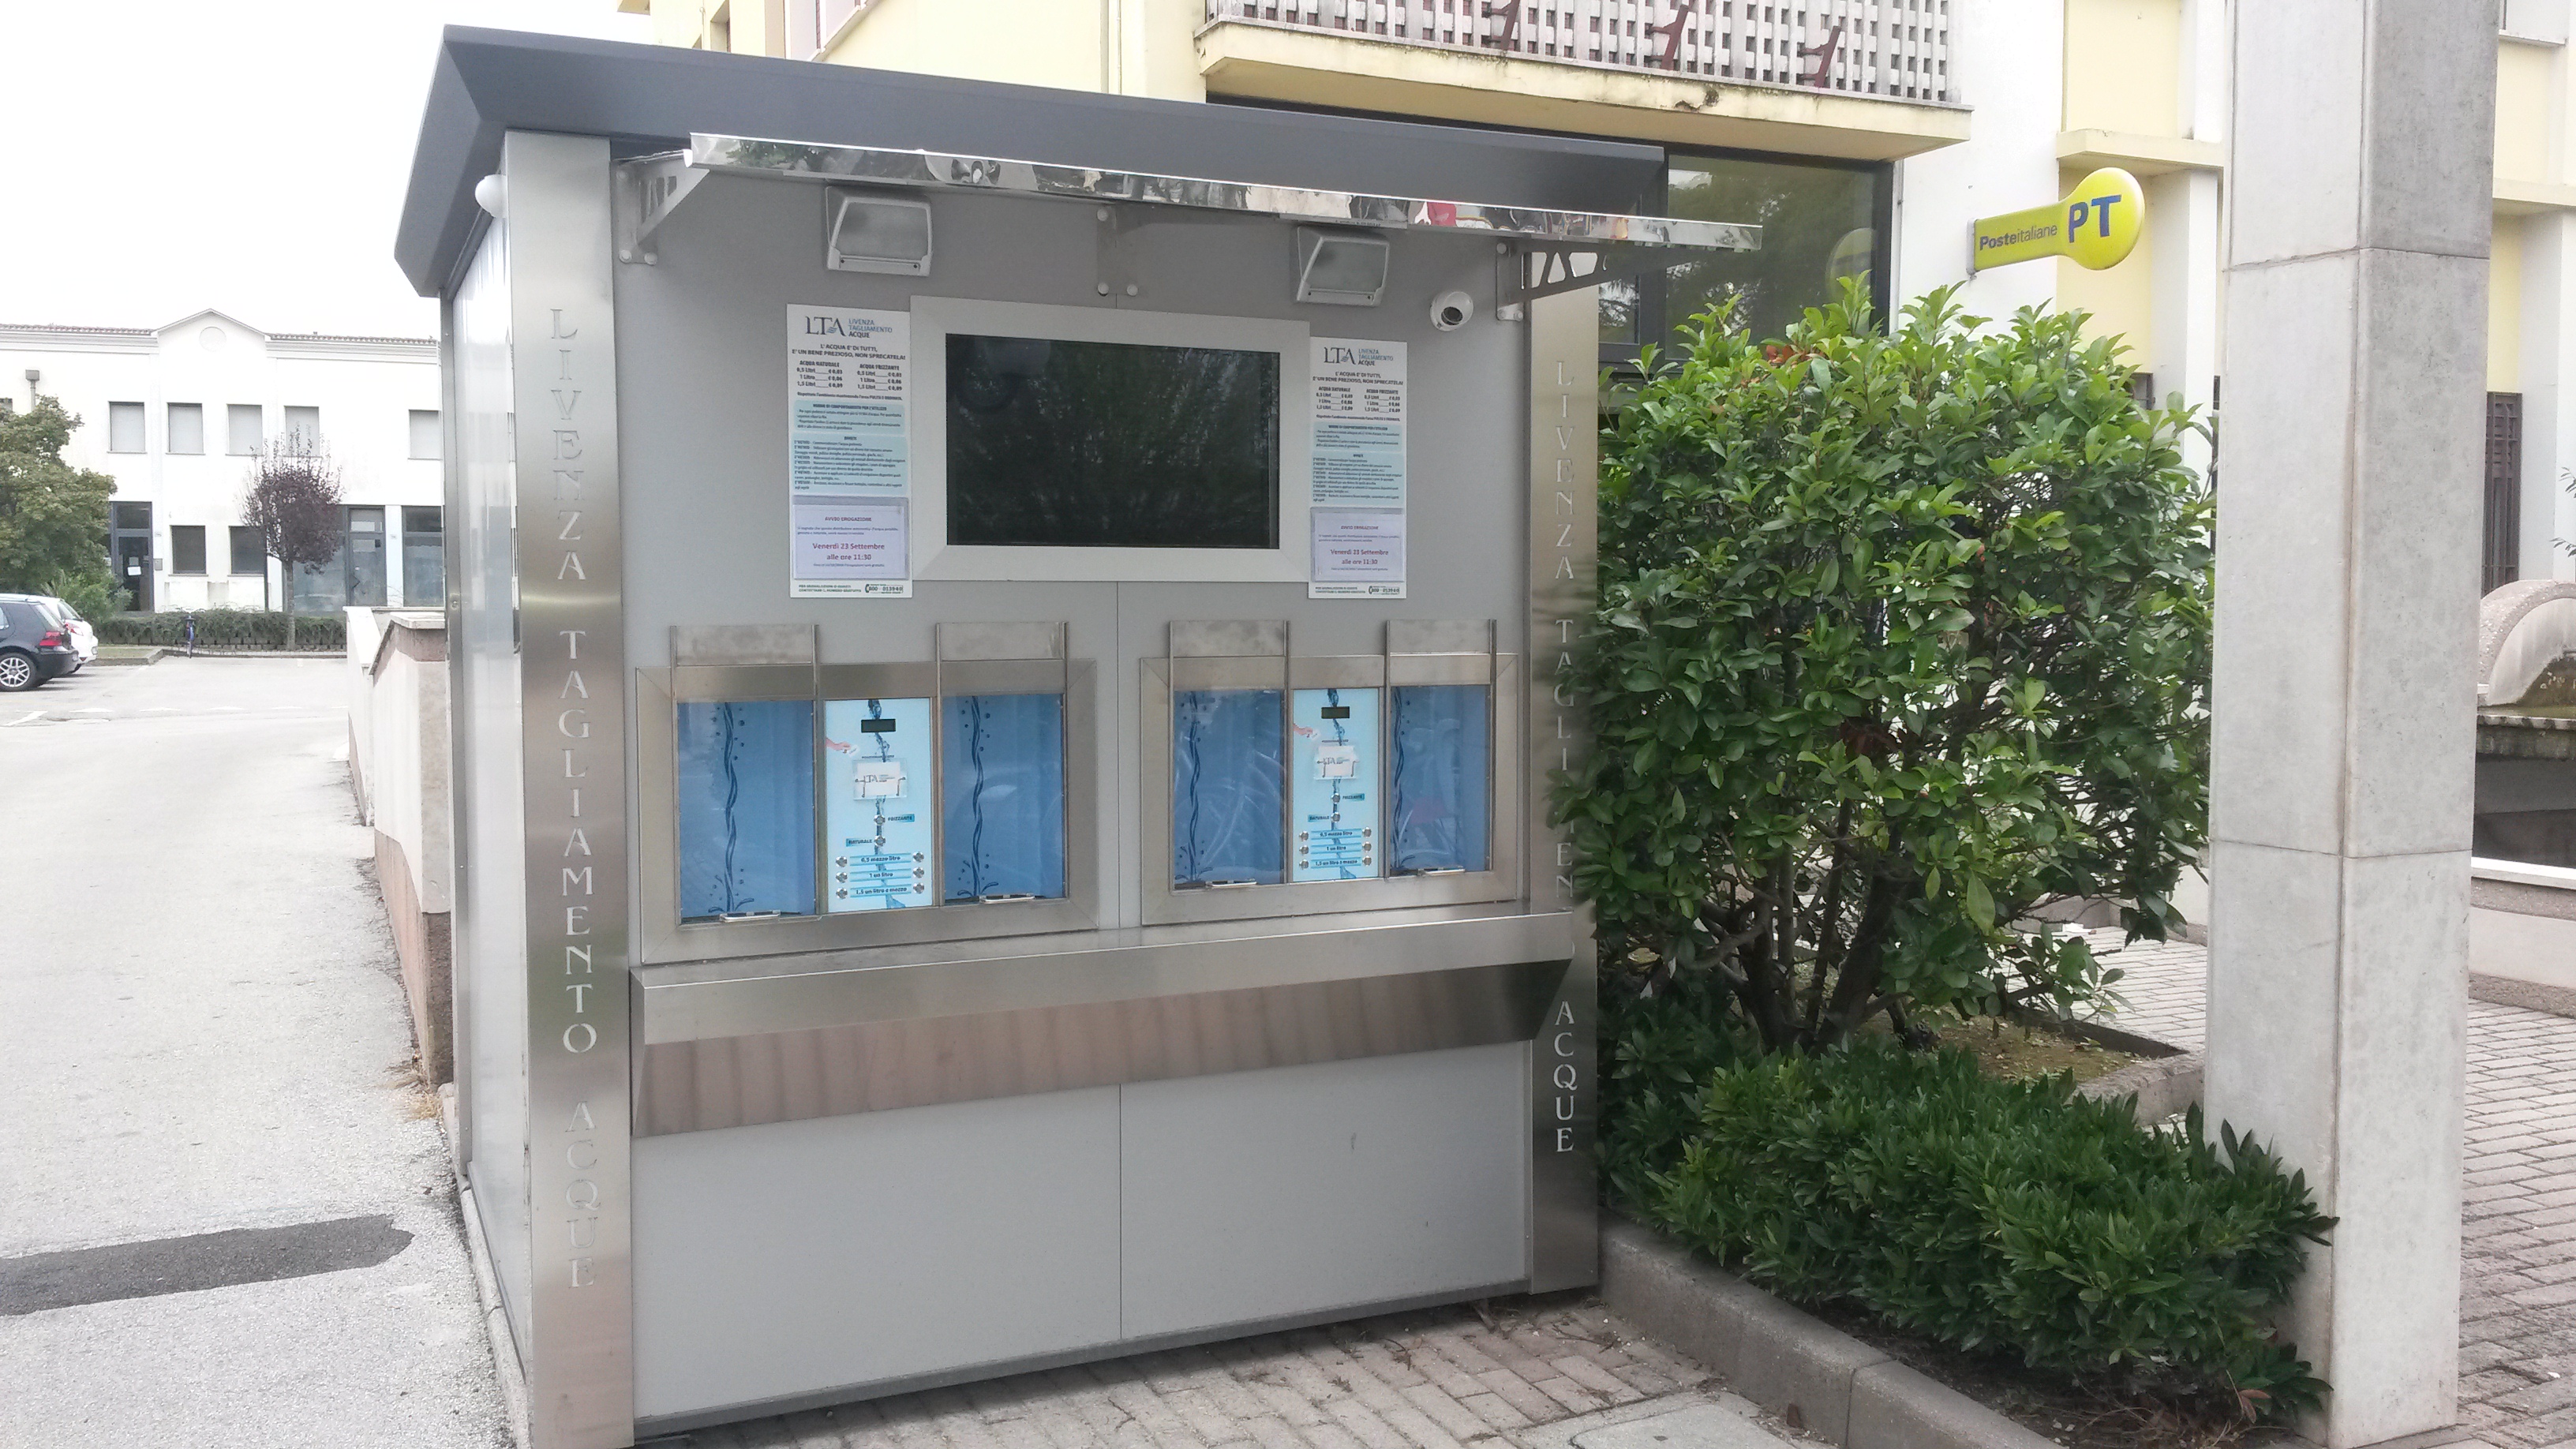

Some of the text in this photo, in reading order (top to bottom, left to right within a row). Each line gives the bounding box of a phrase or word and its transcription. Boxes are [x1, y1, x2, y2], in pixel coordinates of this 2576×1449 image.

[1979, 224, 2057, 251] Posteitaliane
[2069, 194, 2122, 243] PT
[805, 315, 847, 337] LTA
[1324, 346, 1356, 365] LTA
[1553, 361, 1578, 1153] LIVENZA TAGLIEN ACQUE
[550, 309, 601, 1288] LIVENZA TAGLIAMENTO ACQUE
